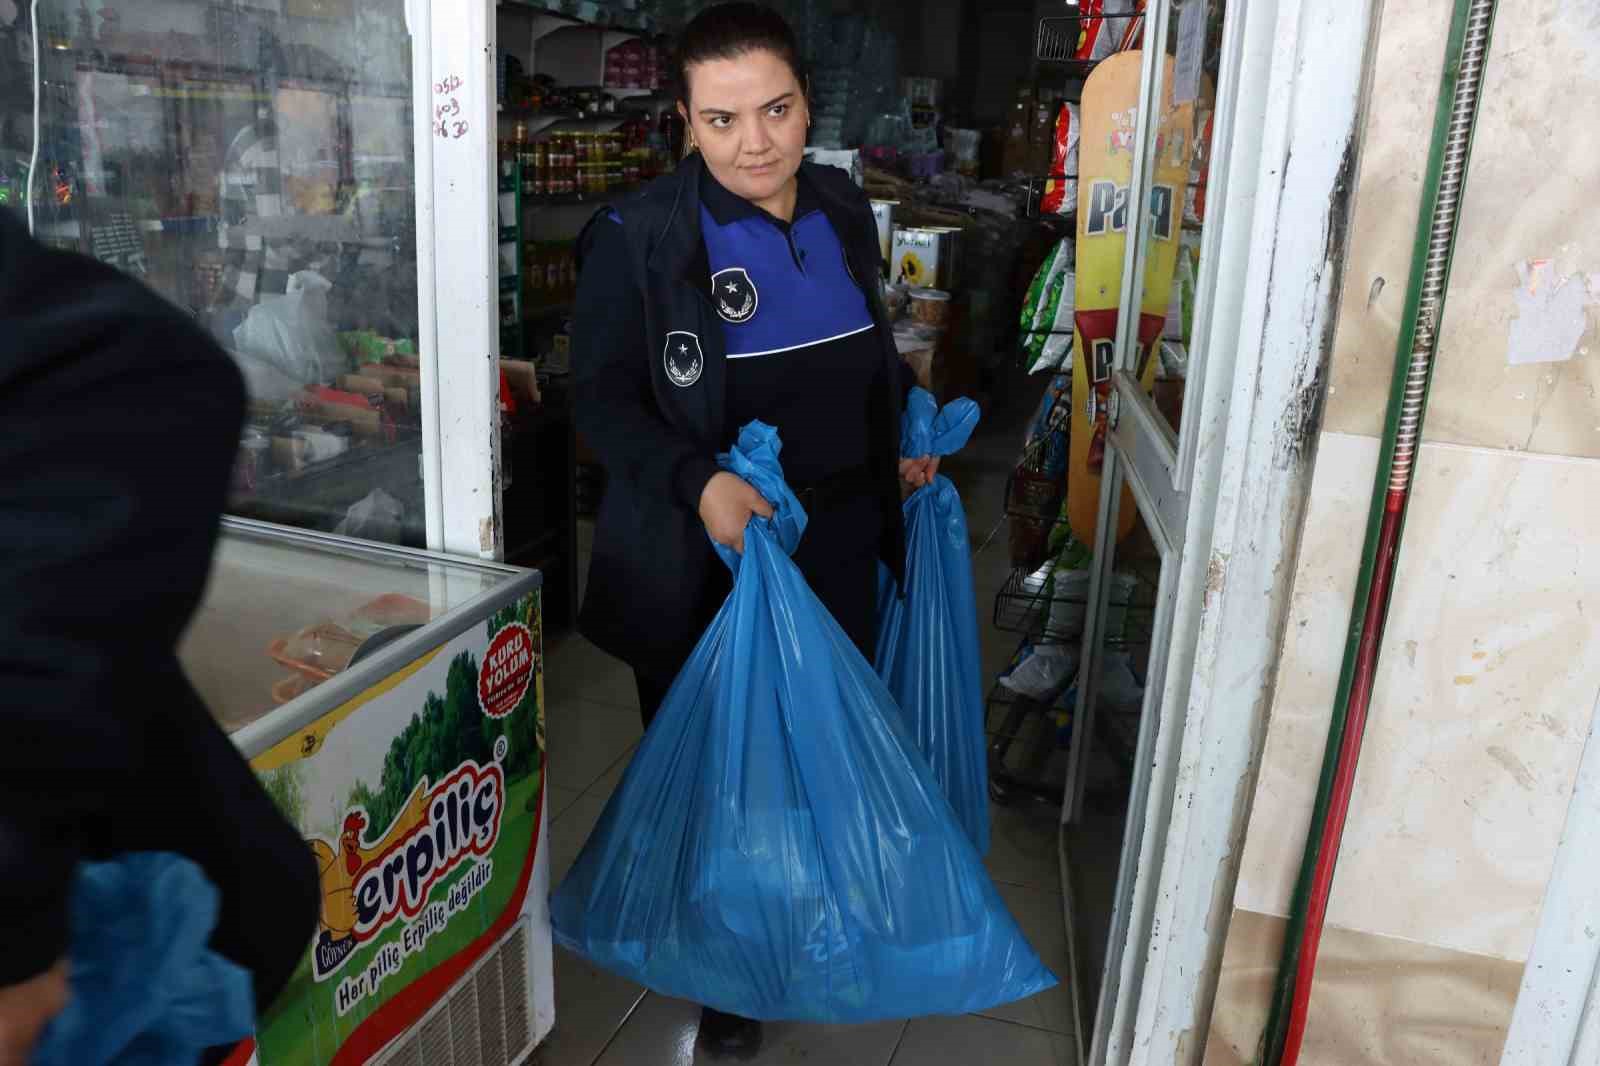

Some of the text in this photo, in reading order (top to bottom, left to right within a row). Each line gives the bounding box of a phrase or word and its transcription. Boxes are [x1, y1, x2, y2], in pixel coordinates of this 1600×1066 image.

[486, 647, 529, 694] YOLUM
[488, 633, 523, 671] KURU
[357, 781, 495, 924] erpiliç
[338, 863, 491, 1011] Her piliç Erpiliç değildir
